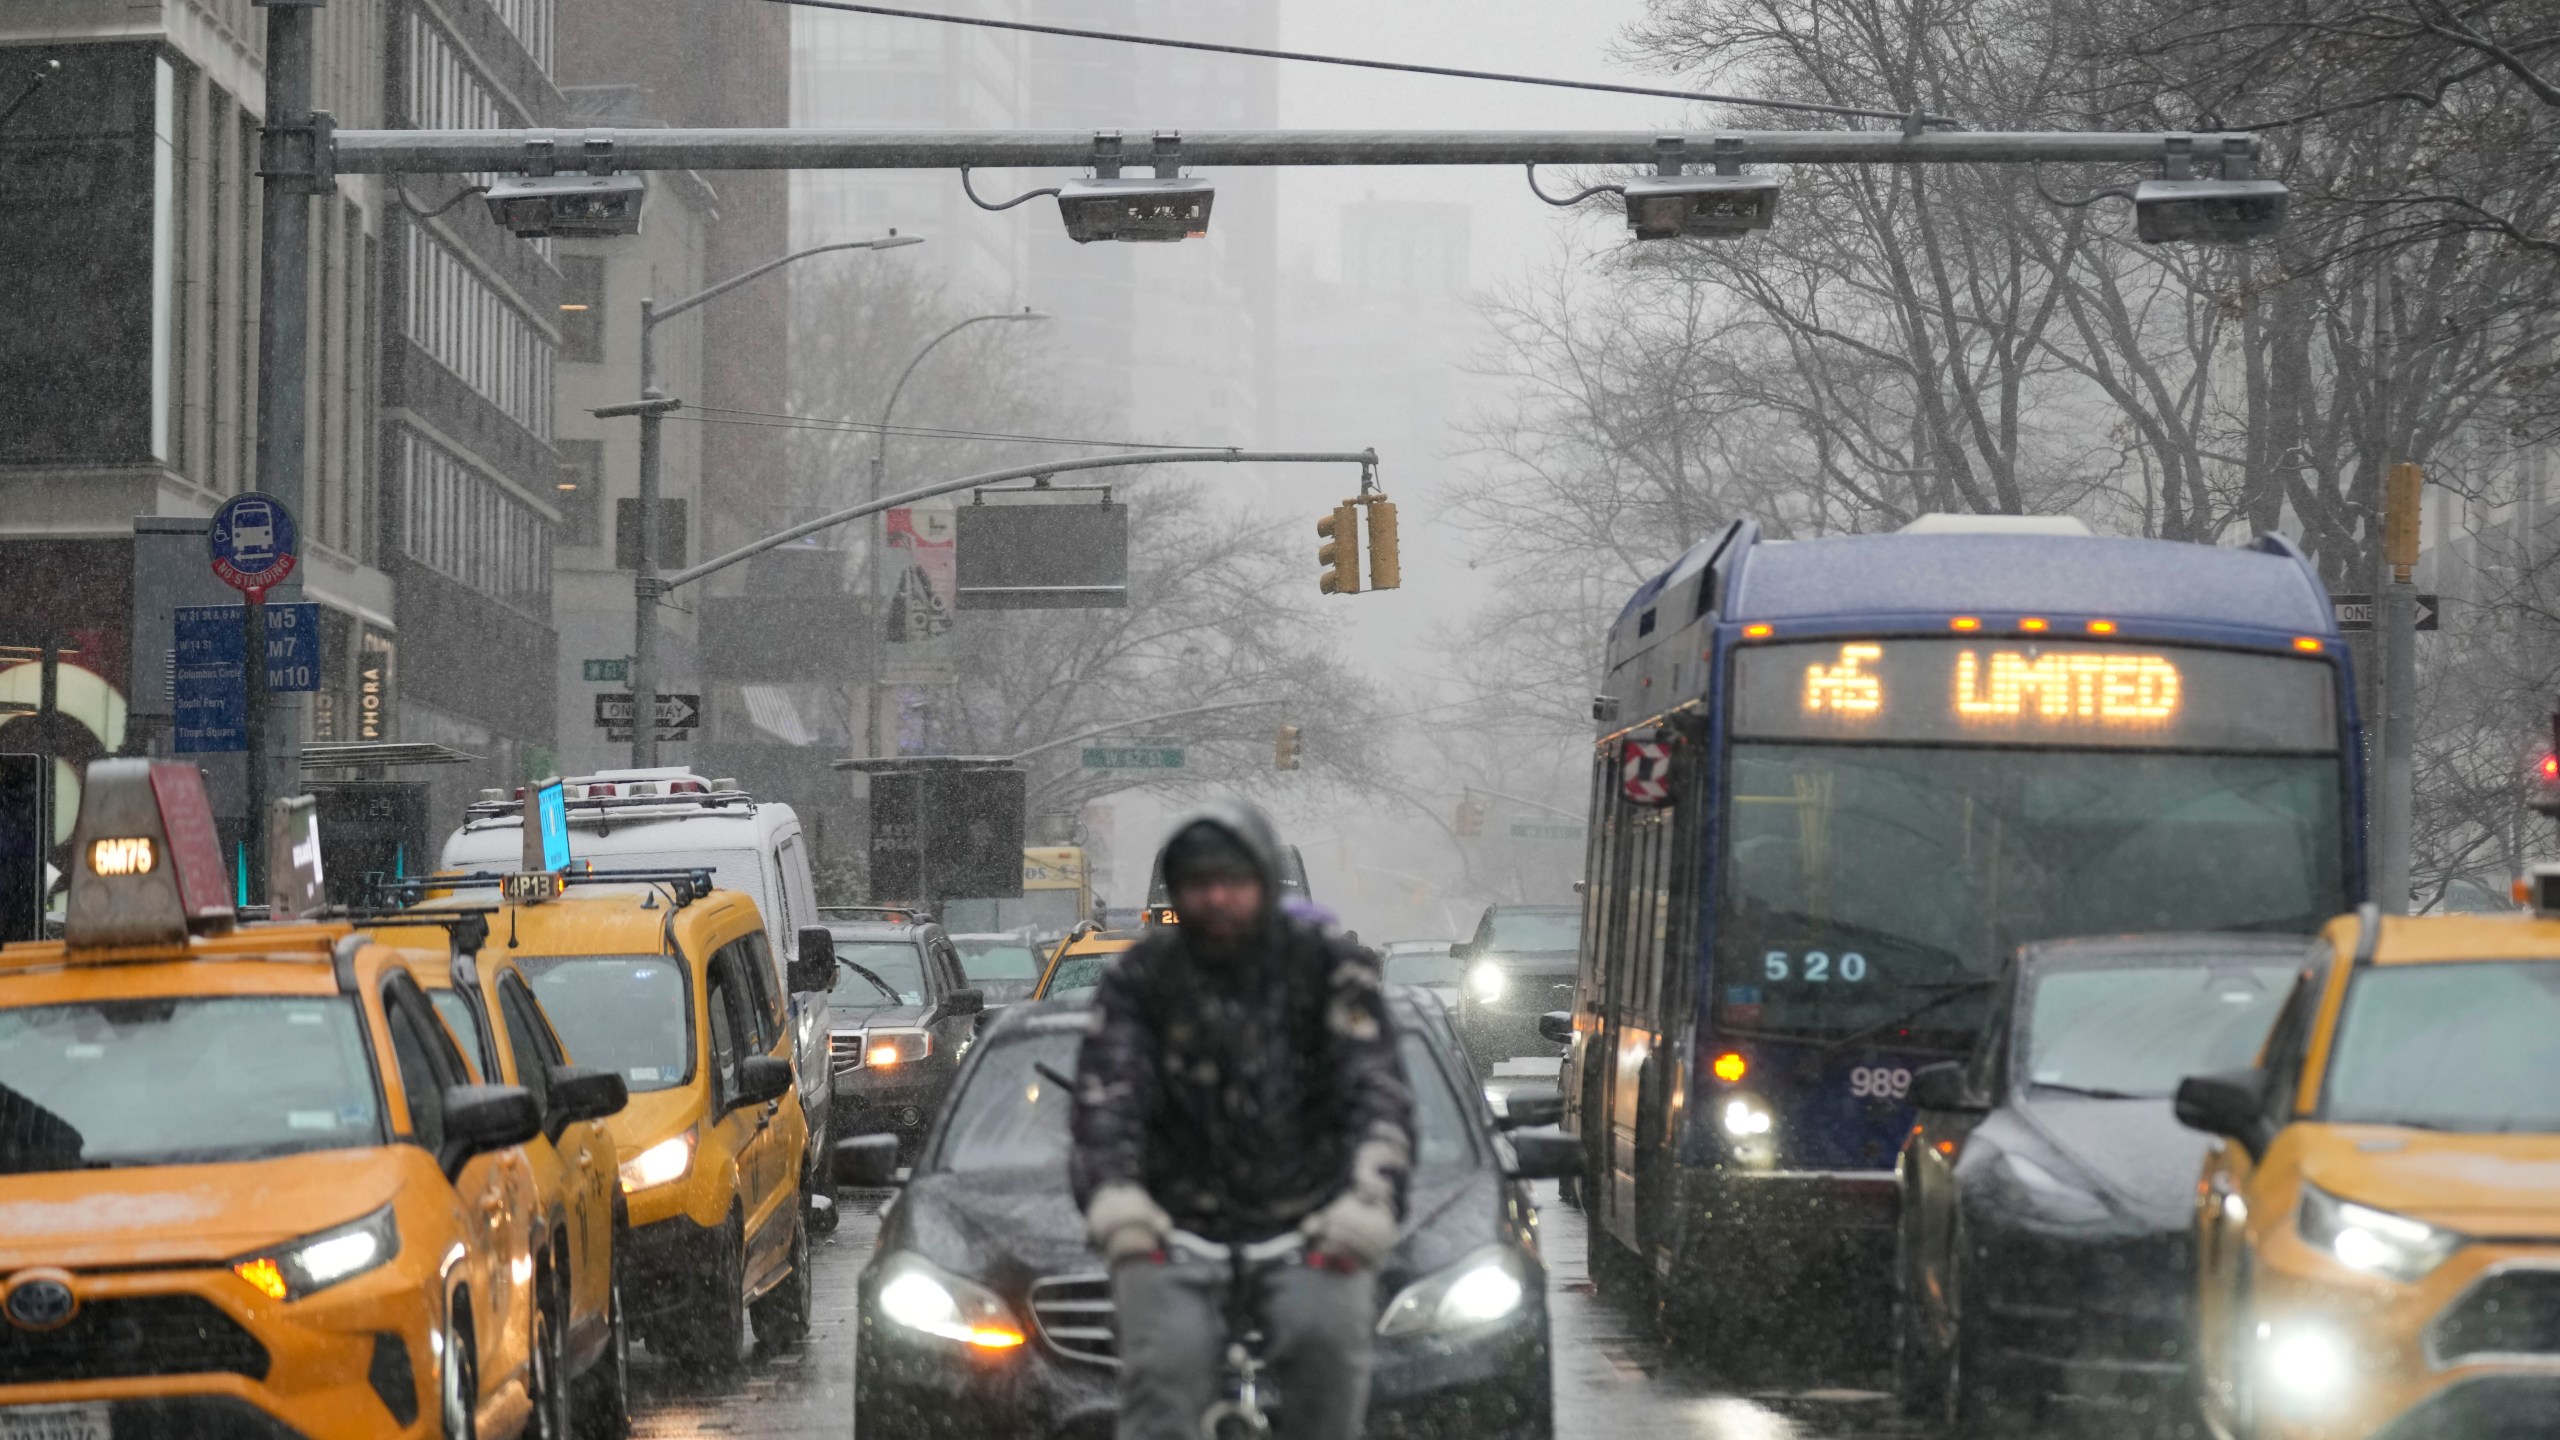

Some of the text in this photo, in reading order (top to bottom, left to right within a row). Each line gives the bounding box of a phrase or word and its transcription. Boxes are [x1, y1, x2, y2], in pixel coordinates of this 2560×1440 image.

[217, 558, 290, 586] NO STANDING
[179, 613, 187, 622] W
[230, 609, 241, 620] Av
[268, 607, 296, 629] M5
[269, 636, 297, 657] M7
[178, 668, 242, 679] Columbus Circle
[269, 666, 310, 687] M10
[1957, 650, 2177, 717] LIMITED
[178, 698, 226, 710] South Ferry
[610, 703, 634, 717] ON
[179, 727, 236, 738] Times Square
[509, 876, 550, 898] 4P13
